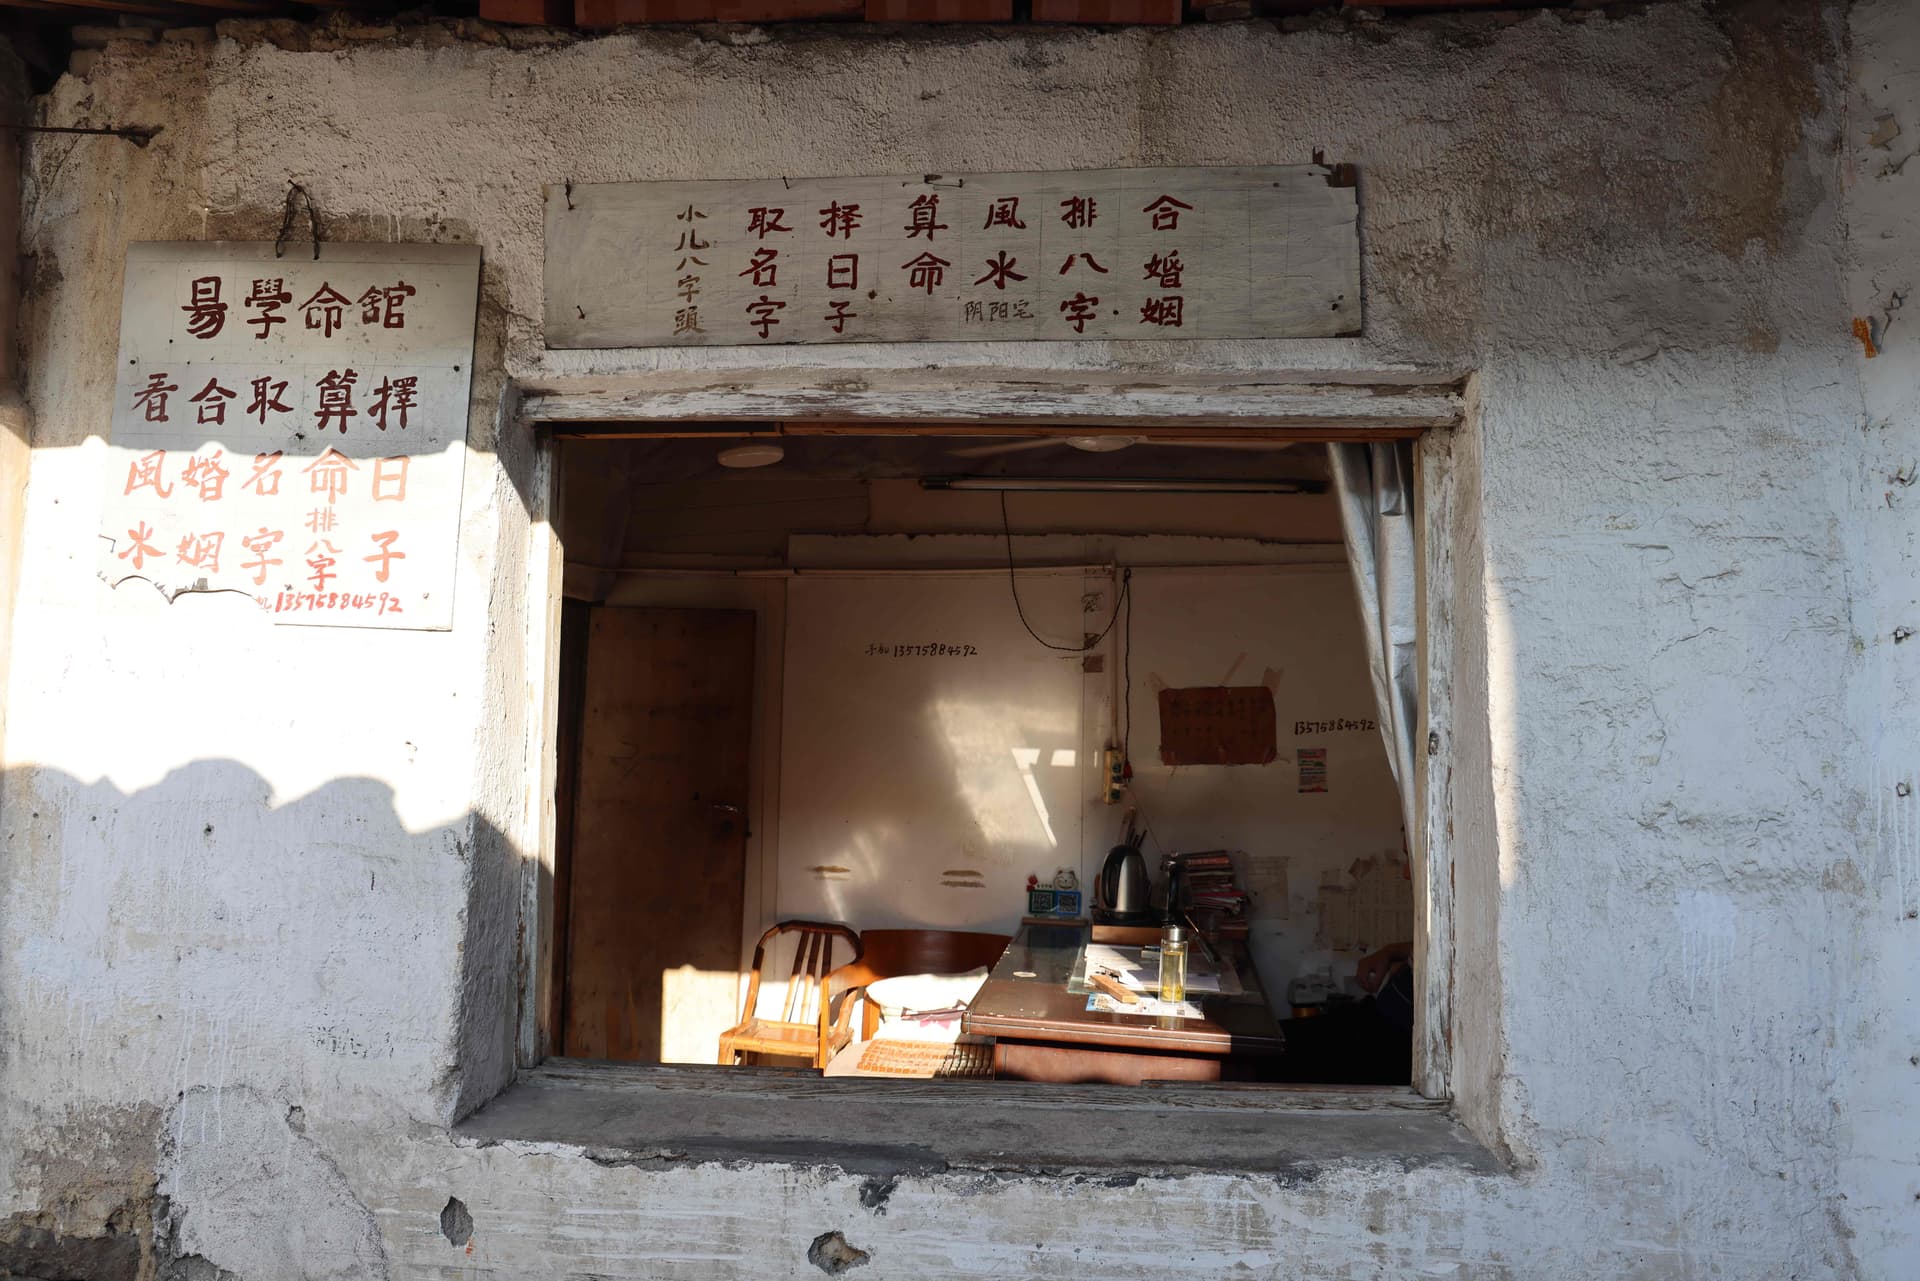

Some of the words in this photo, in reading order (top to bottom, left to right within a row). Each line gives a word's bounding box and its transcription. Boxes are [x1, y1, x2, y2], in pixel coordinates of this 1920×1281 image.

[739, 206, 792, 339] 取名字
[819, 200, 863, 333] 择日子
[902, 194, 951, 295] 算命
[1059, 196, 1109, 333] 排八字
[275, 593, 403, 615] 13575884592
[894, 642, 977, 658] 13575884592
[1294, 718, 1376, 735] 13575884592
